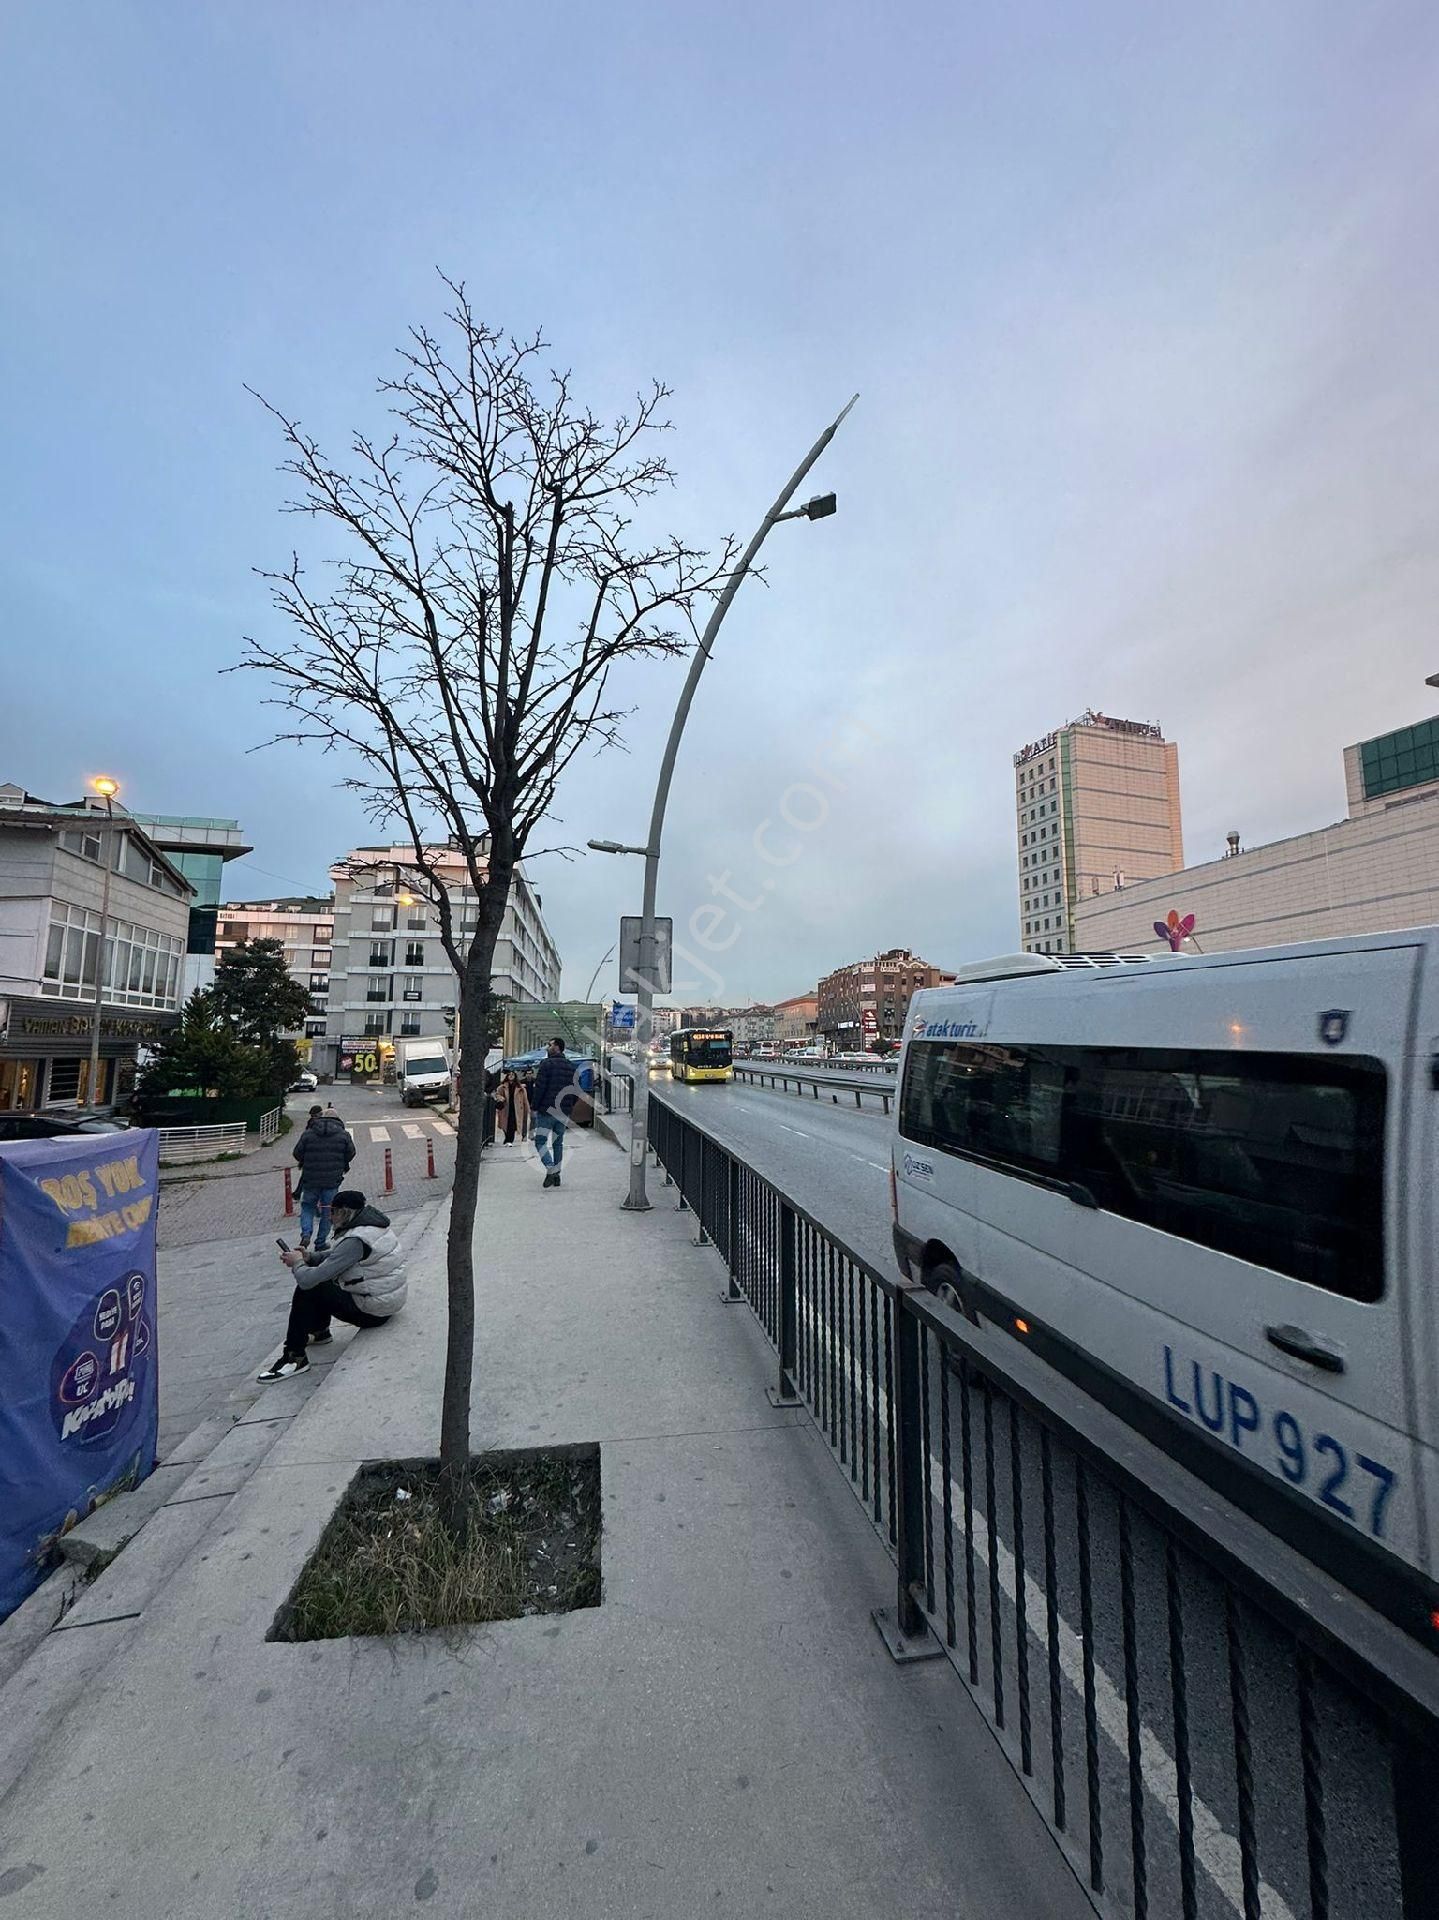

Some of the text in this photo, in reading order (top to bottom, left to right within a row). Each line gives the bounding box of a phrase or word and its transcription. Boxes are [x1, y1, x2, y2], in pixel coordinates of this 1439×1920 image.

[95, 1156, 146, 1197] YOK
[1163, 1344, 1396, 1537] LUP 927
